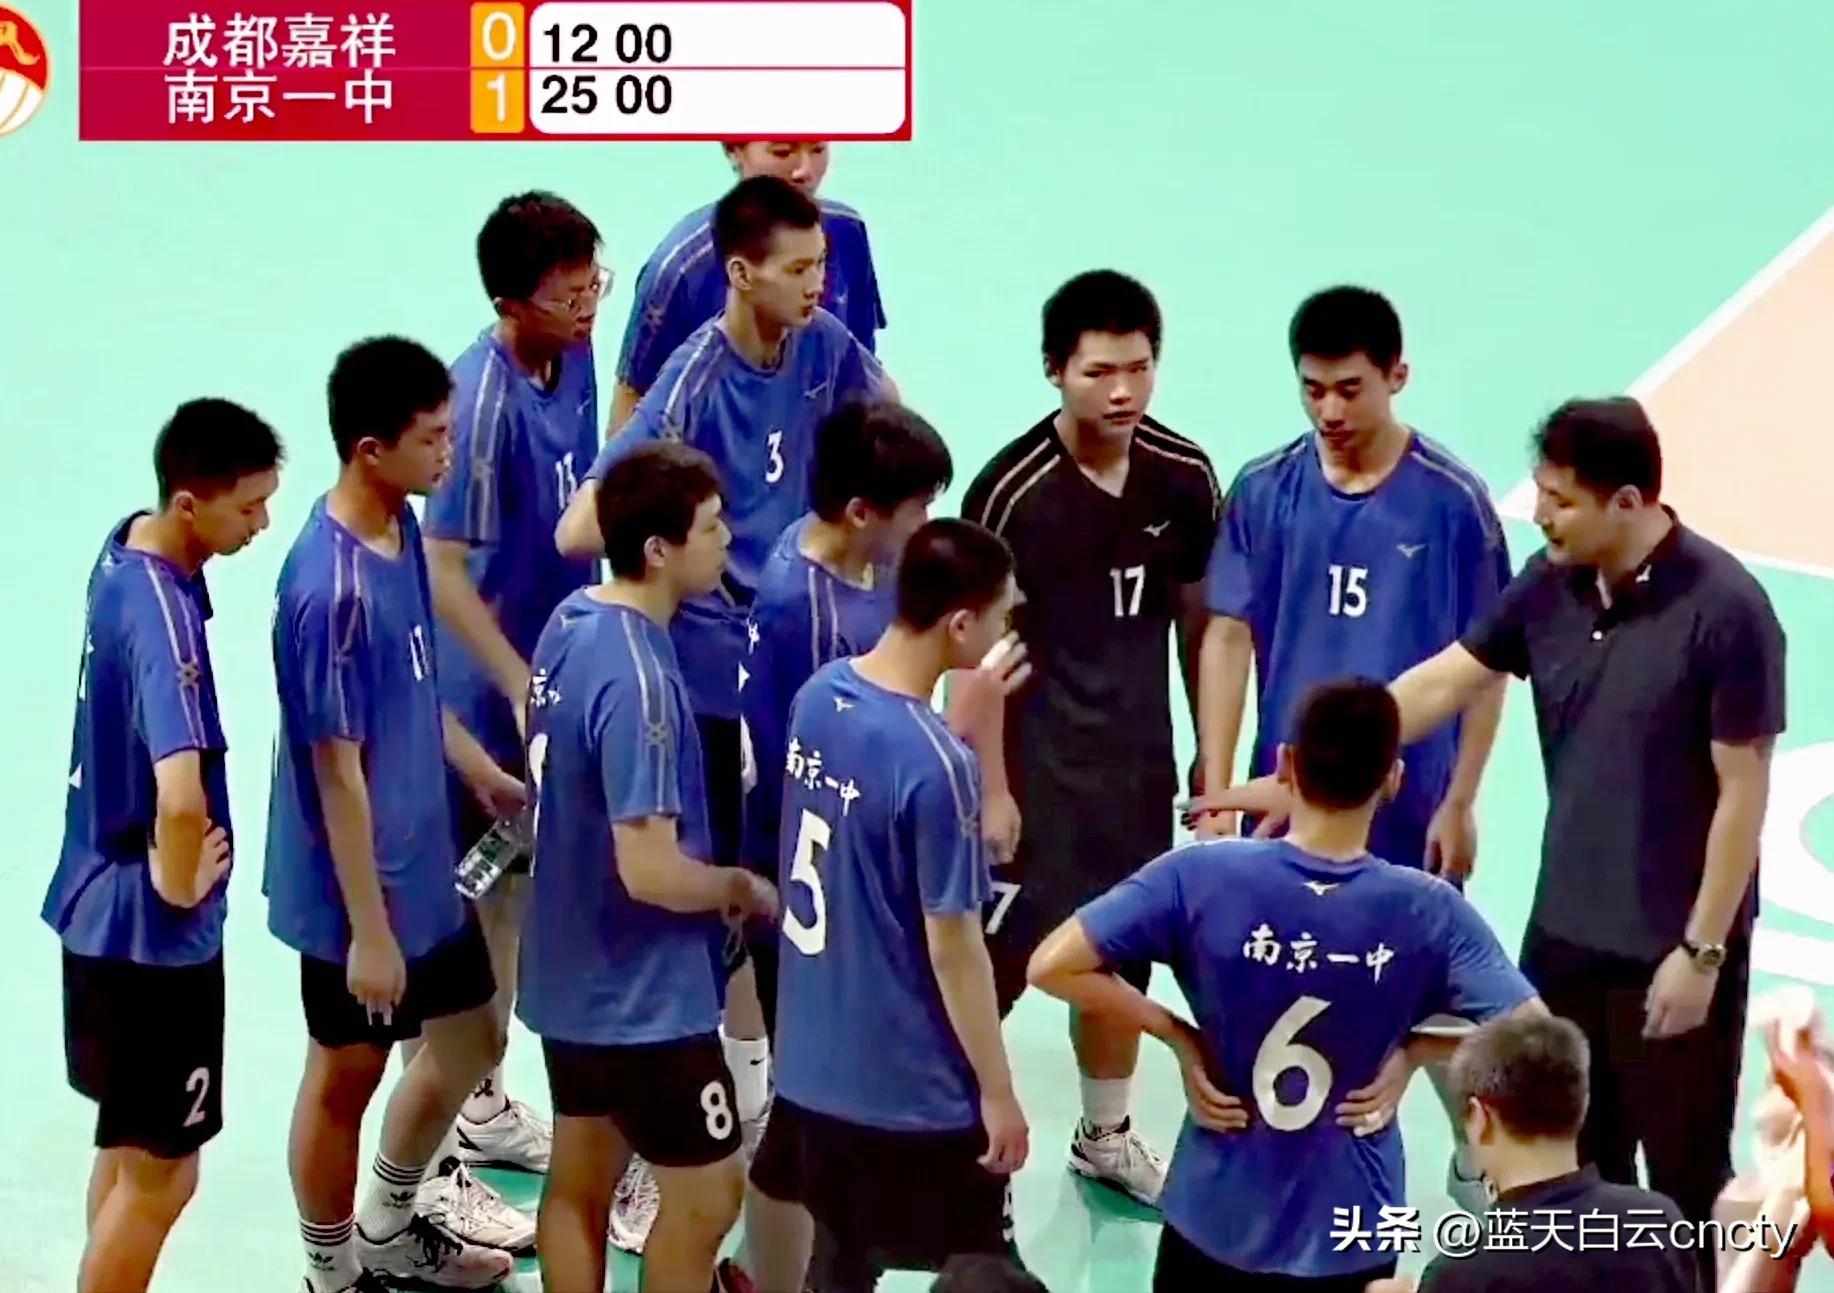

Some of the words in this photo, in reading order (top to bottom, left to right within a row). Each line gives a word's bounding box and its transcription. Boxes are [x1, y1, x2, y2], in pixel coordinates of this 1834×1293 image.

[765, 430, 784, 484] 3
[1109, 564, 1146, 618] 17
[1328, 564, 1369, 618] 15
[785, 737, 862, 817] 南京一中
[782, 808, 831, 956] 5
[1243, 923, 1395, 984] 南京一中
[1252, 995, 1333, 1132] 6
[183, 1066, 210, 1127] 2
[701, 1080, 734, 1140] 8
